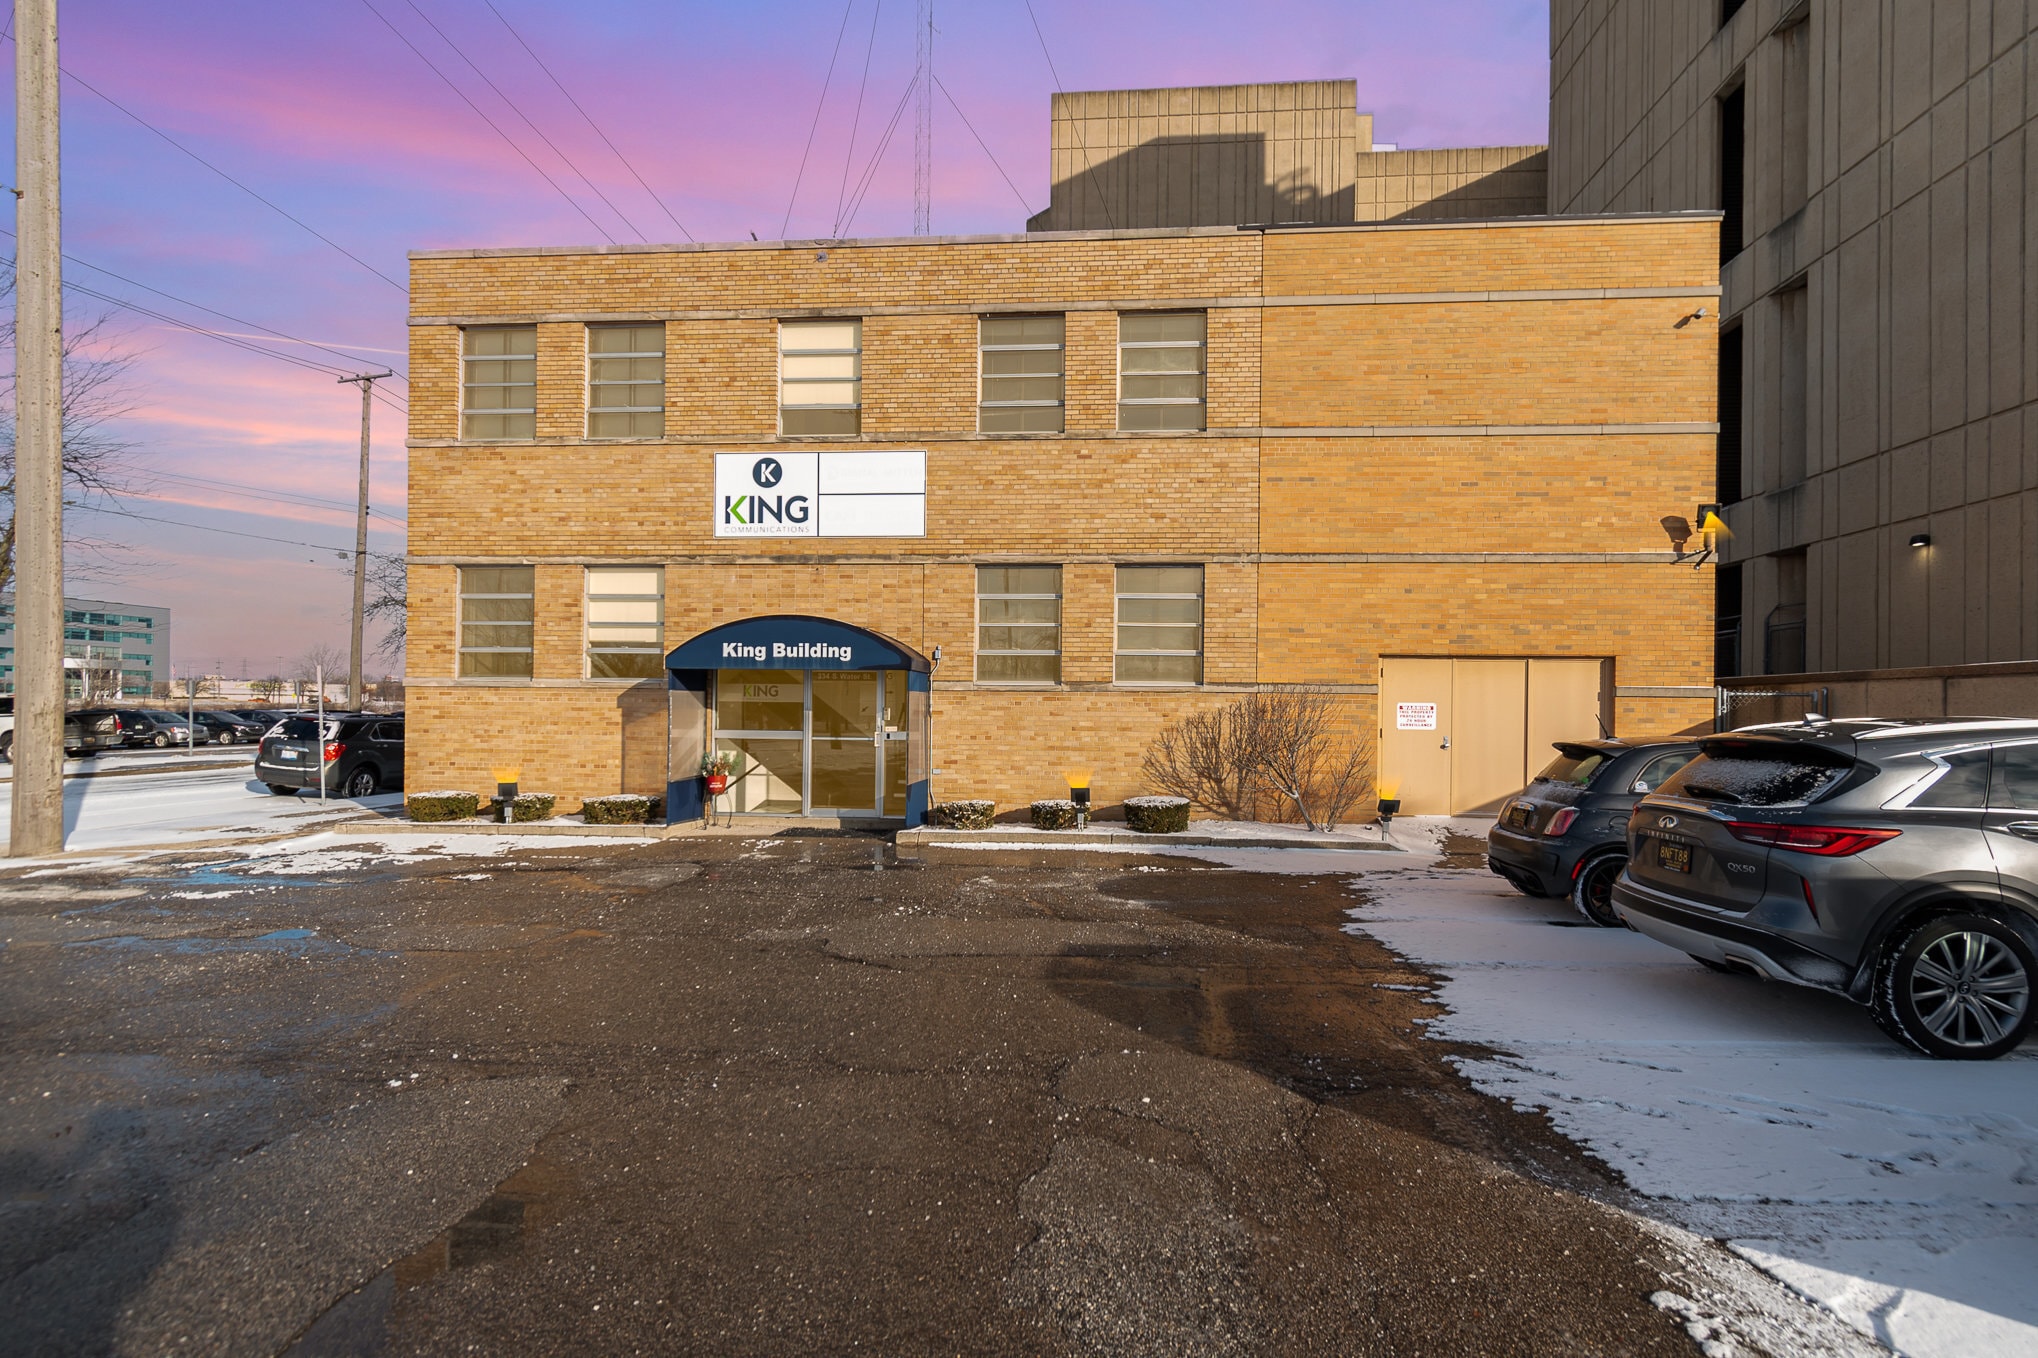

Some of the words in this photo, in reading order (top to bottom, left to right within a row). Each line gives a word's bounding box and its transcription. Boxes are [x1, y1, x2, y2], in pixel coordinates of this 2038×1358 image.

[761, 463, 777, 483] K
[724, 495, 809, 524] KING
[724, 526, 810, 534] COMMUNICATIONS
[722, 642, 767, 661] King
[772, 642, 852, 662] Building
[743, 685, 779, 698] KING
[1647, 830, 1685, 843] INFINITI
[1727, 862, 1756, 873] QX50
